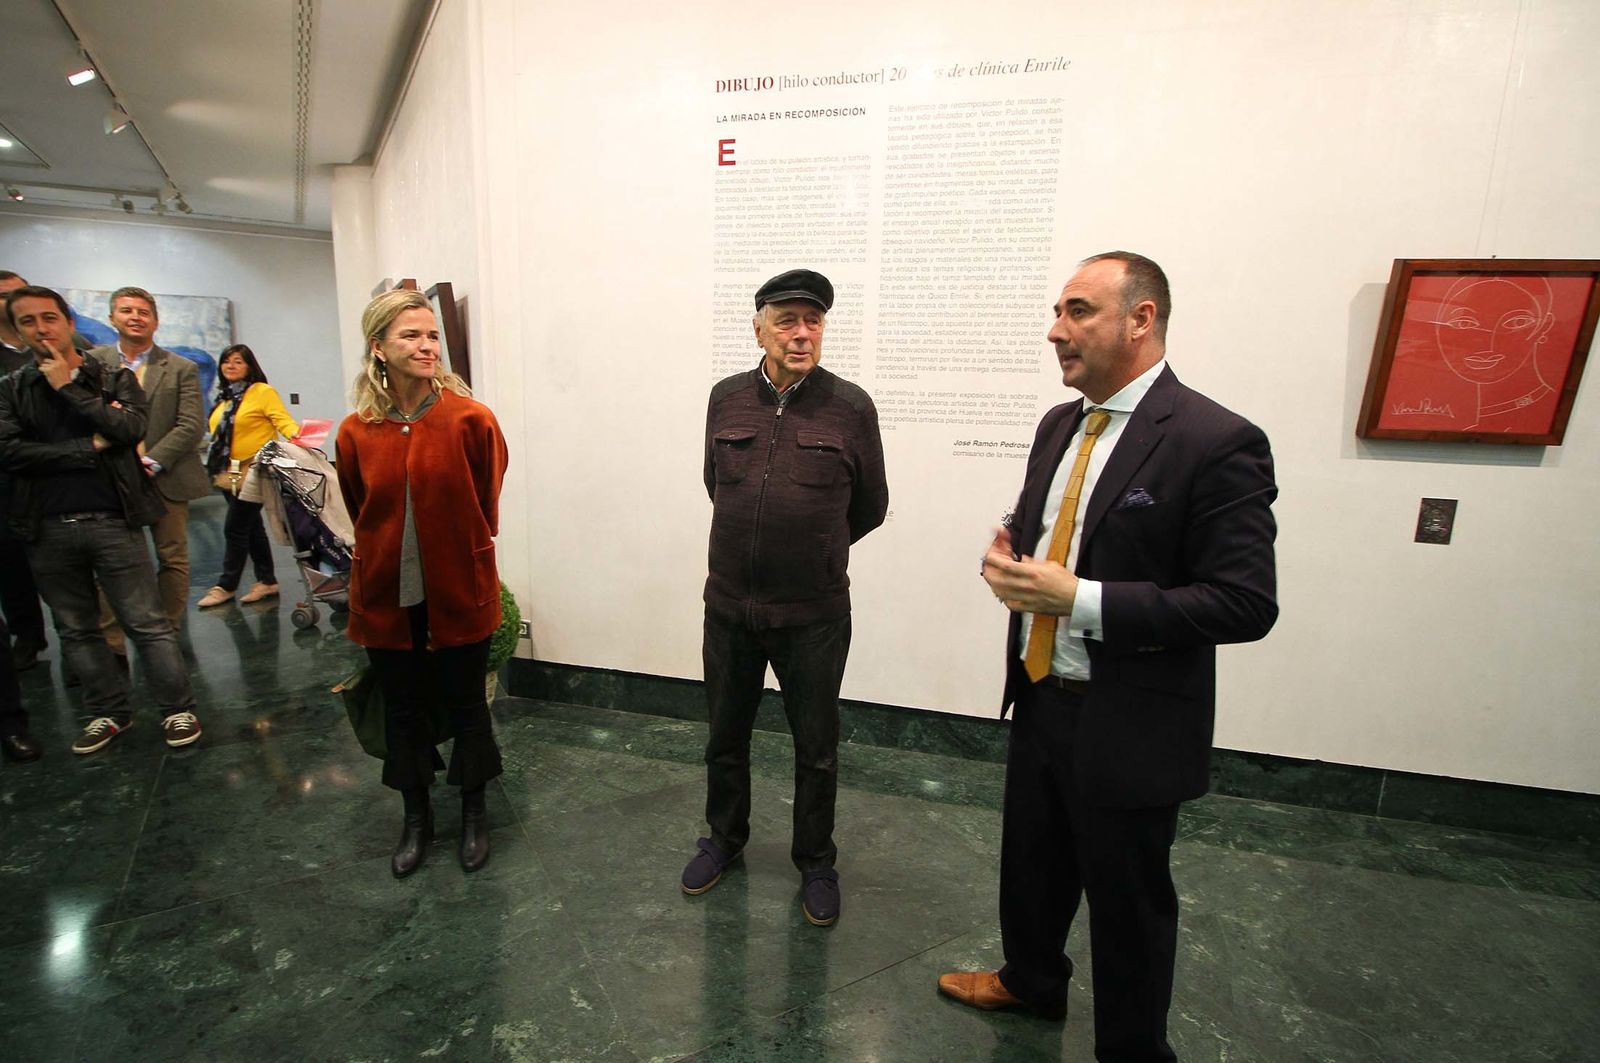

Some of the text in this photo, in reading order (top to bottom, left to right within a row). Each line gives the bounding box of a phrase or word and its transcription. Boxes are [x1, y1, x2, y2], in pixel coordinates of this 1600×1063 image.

[716, 76, 774, 93] DIBUJO
[778, 74, 809, 91] [hilo
[812, 68, 885, 86] conductor]
[948, 63, 966, 78] de
[969, 60, 1019, 77] clínica
[1023, 56, 1072, 73] Enrile
[716, 106, 866, 123] LA MIRADA EN RECOMPOSICIÓN
[953, 439, 1030, 449] José Ramón Pedrosa
